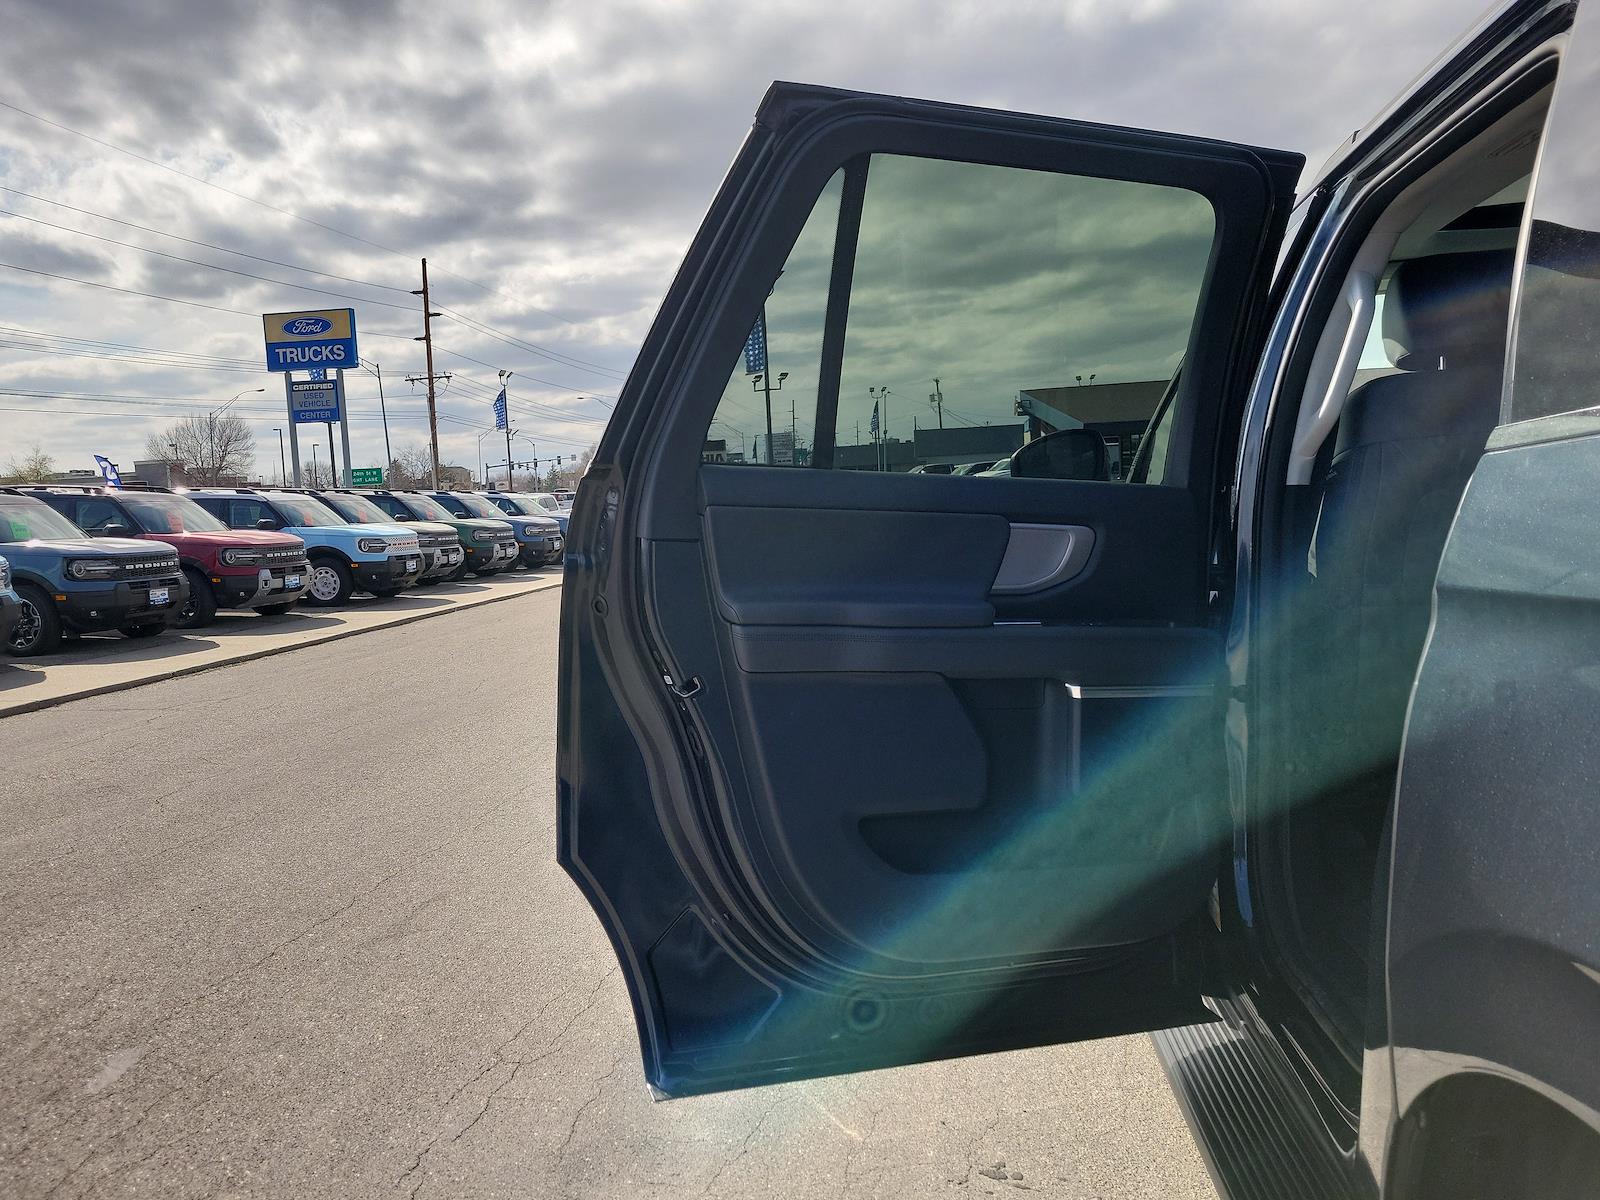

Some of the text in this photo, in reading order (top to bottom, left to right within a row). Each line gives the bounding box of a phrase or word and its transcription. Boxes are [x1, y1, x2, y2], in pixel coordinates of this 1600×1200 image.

[292, 319, 322, 333] Ford
[275, 345, 345, 364] TRUCKS
[292, 383, 334, 391] CERTIFIED
[299, 400, 331, 408] VEHICLE
[300, 411, 331, 419] CENTER
[125, 561, 175, 569] BRONCO
